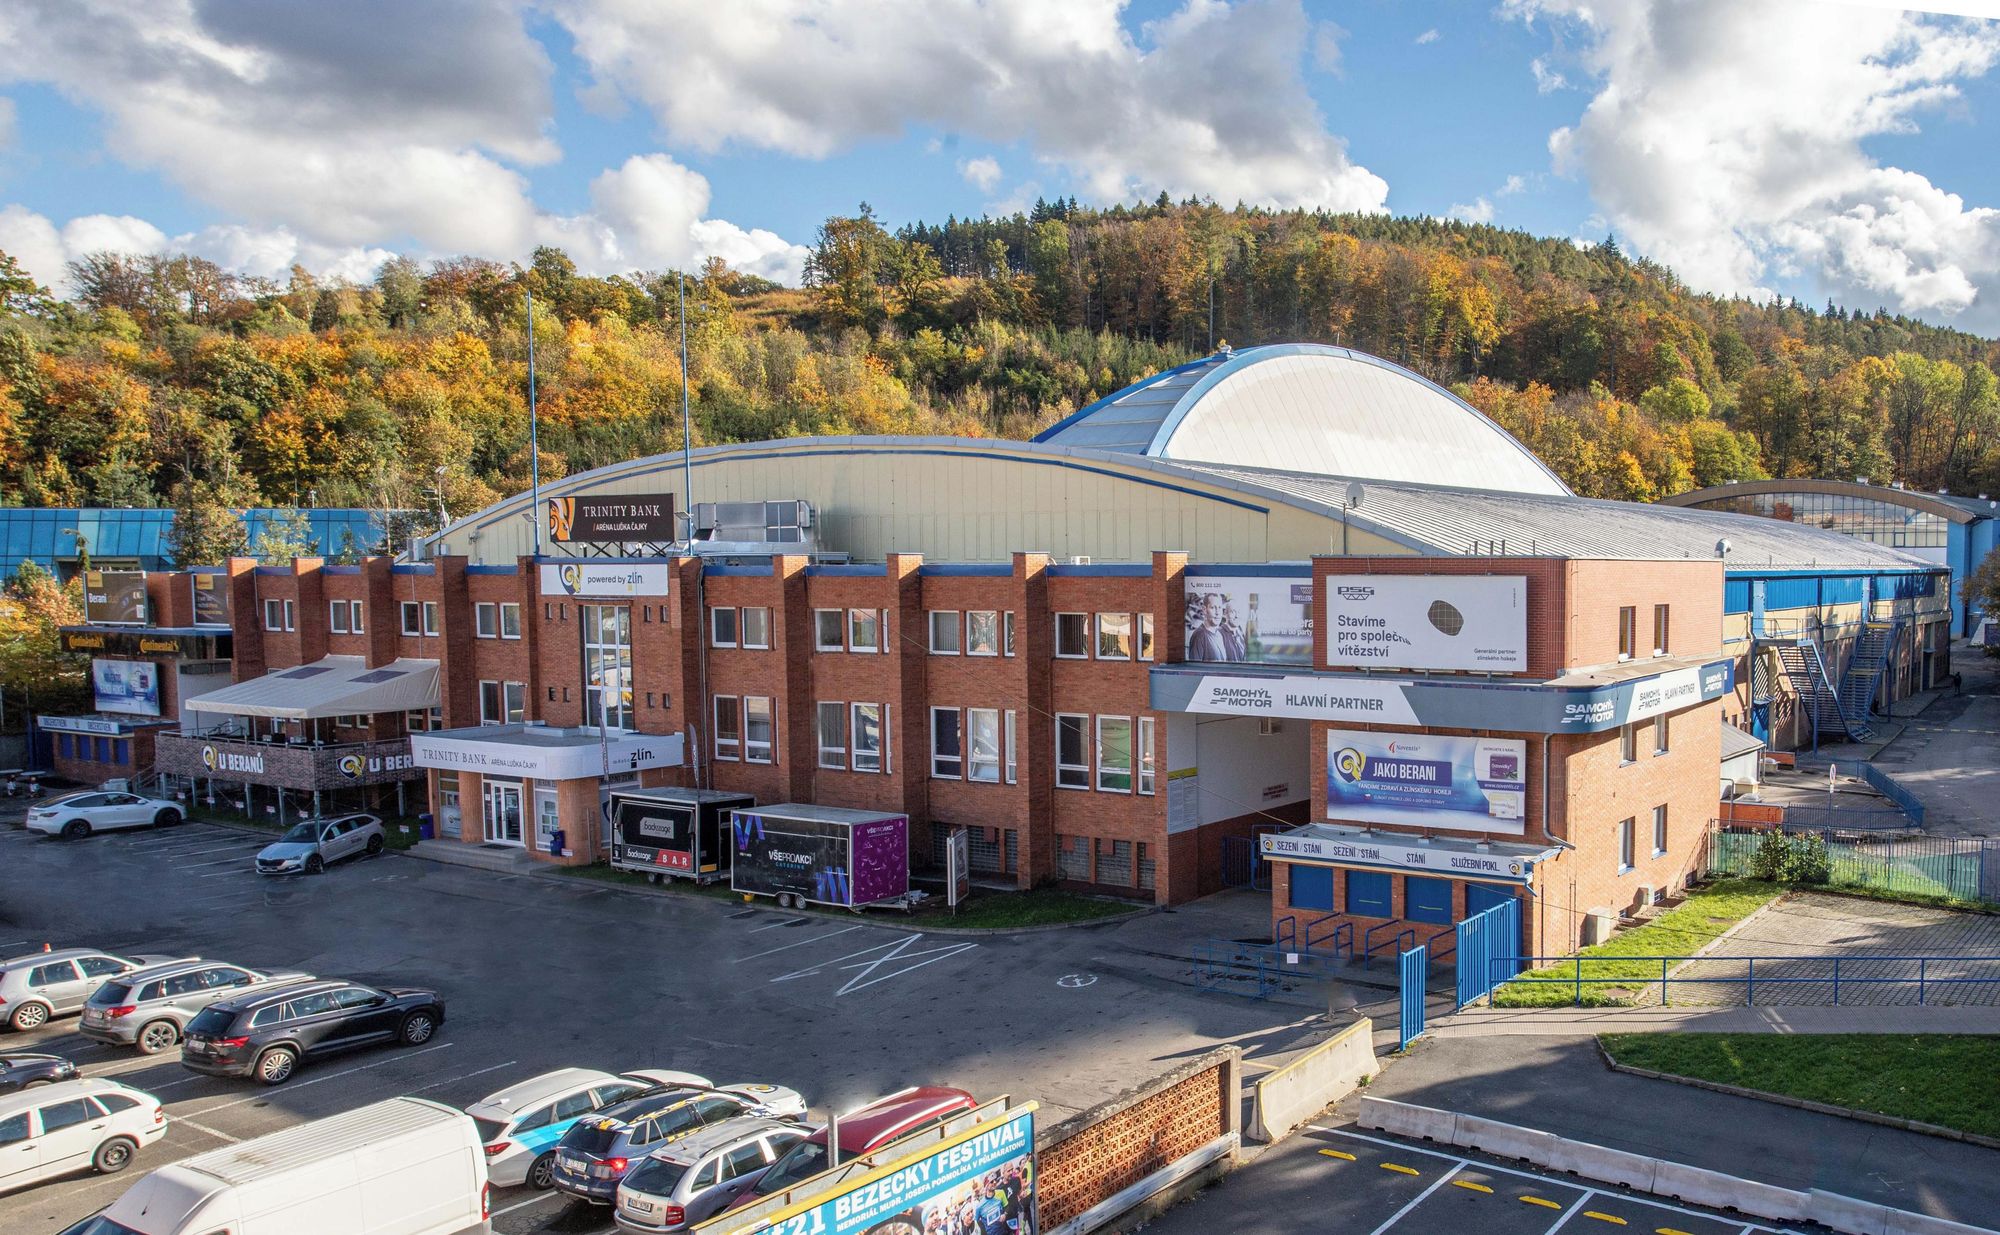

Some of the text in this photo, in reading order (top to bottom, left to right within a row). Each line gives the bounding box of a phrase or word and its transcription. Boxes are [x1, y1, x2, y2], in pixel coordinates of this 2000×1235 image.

[583, 505, 660, 517] TRINITY BANK
[596, 522, 613, 531] ARÉNA
[631, 521, 648, 531] ČAJKY
[587, 575, 616, 584] powered
[617, 575, 626, 584] by
[88, 592, 107, 604] Berani
[1338, 614, 1386, 628] Stavíme
[69, 634, 102, 649] Continental
[1338, 632, 1357, 644] pro
[140, 638, 175, 654] Continental
[1338, 644, 1389, 658] vítězství
[1213, 687, 1272, 699] SAMOHÝL
[1228, 698, 1272, 708] MOTOR
[1286, 693, 1384, 711] HLAVNÍ PARTNER
[1565, 699, 1614, 714] SAMOHÝL
[1584, 709, 1614, 724] MOTOR
[218, 752, 264, 774] U BERANŮ
[422, 749, 488, 765] TRINITY BANK
[368, 758, 381, 772] U
[1373, 762, 1436, 781] JAKO BERANI
[1276, 840, 1299, 852] SEZENÍ
[1304, 842, 1322, 855] STÁNÍ
[1333, 845, 1356, 858] SEZENÍ
[1361, 848, 1380, 860] STÁNÍ
[662, 854, 688, 867] BAR
[1406, 852, 1426, 865] STÁNÍ
[1451, 857, 1482, 870] SLUŽEBNÍ
[937, 1119, 1025, 1175] FESTIVAL
[836, 1207, 879, 1233] MEMORIÁL
[904, 1182, 931, 1201] JOSEFA
[931, 1164, 972, 1191] PODMOLÍKA
[972, 1161, 978, 1169] V
[978, 1139, 1026, 1167] PŮLMARATONU
